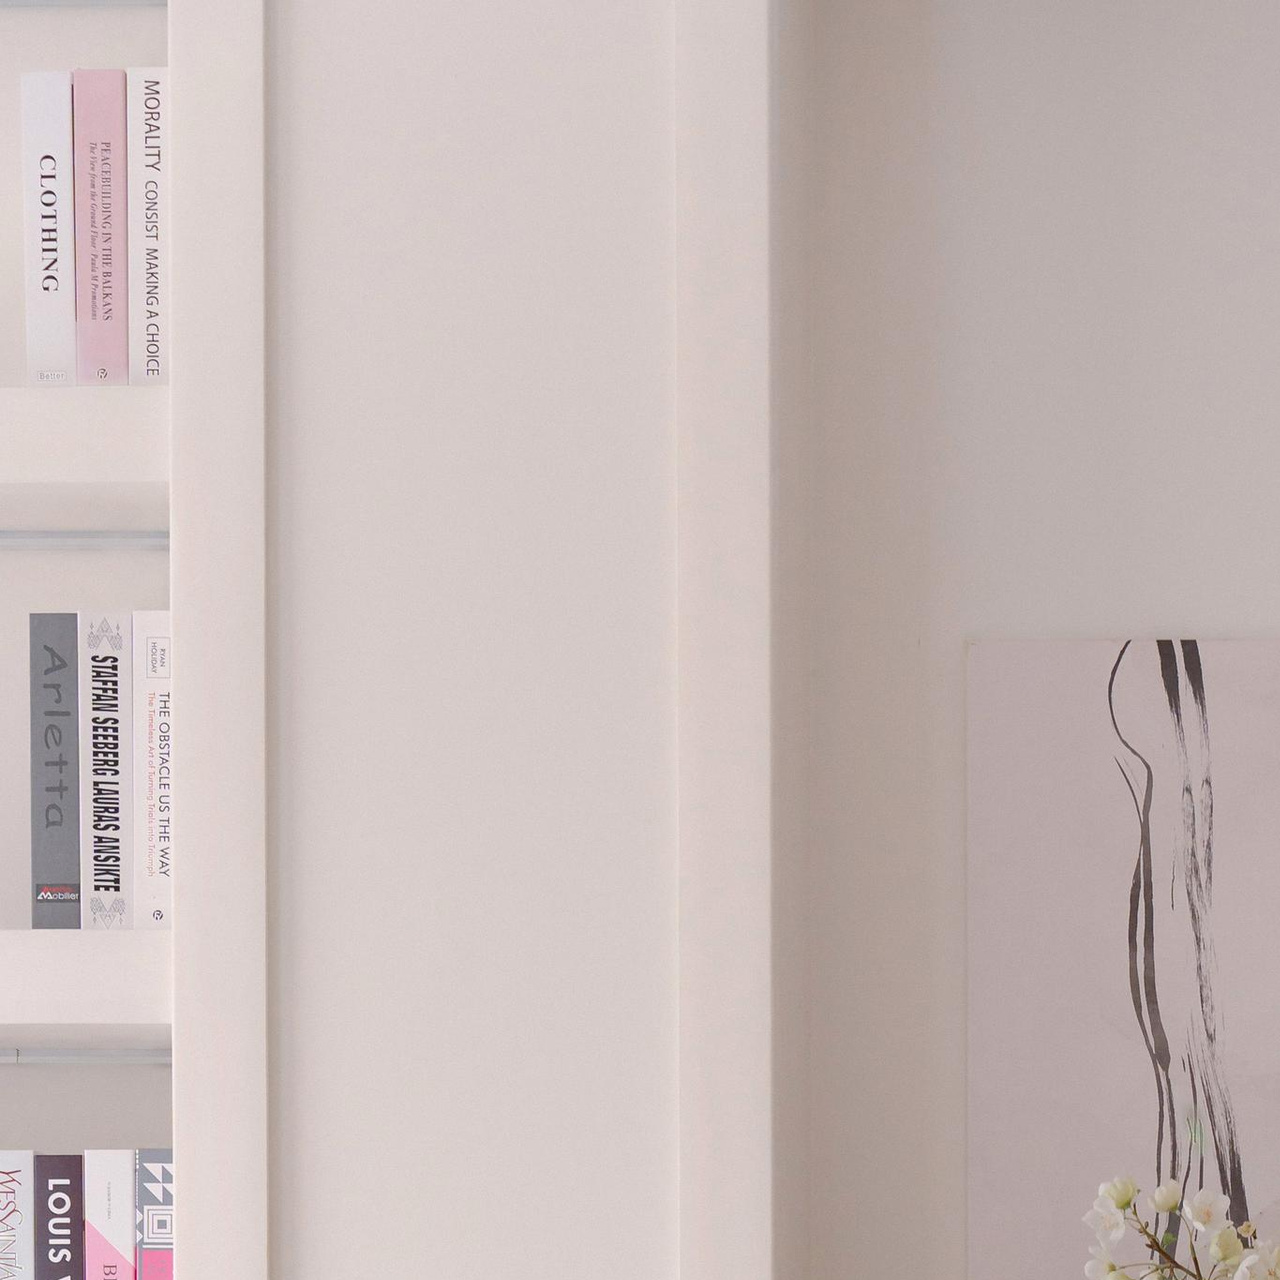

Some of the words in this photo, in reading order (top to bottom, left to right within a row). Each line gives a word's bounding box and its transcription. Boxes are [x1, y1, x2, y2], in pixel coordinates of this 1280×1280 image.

[144, 80, 161, 172] MORALITY
[101, 142, 112, 229] PEACEBUILDING
[145, 180, 158, 241] CONSIST
[40, 154, 59, 293] CLOTHING
[102, 232, 112, 243] IN
[102, 247, 112, 268] THE
[146, 248, 159, 306] MAKING
[102, 271, 112, 321] BALKANS
[147, 310, 159, 320] A
[146, 323, 160, 376] CHOICE
[91, 655, 119, 712] STAFFAN
[159, 692, 170, 718] THE
[44, 645, 71, 829] Arletta
[92, 717, 120, 776] SEEBERG
[159, 722, 170, 790] OBSTACLE
[147, 771, 156, 801] Turning
[149, 760, 156, 769] of
[93, 781, 120, 831] LAURAS
[159, 795, 170, 812] US
[159, 817, 170, 842] THE
[93, 835, 120, 892] ANSIKTE
[147, 844, 156, 877] Triumph
[160, 847, 170, 877] WAY
[48, 1178, 71, 1263] LOUIS
